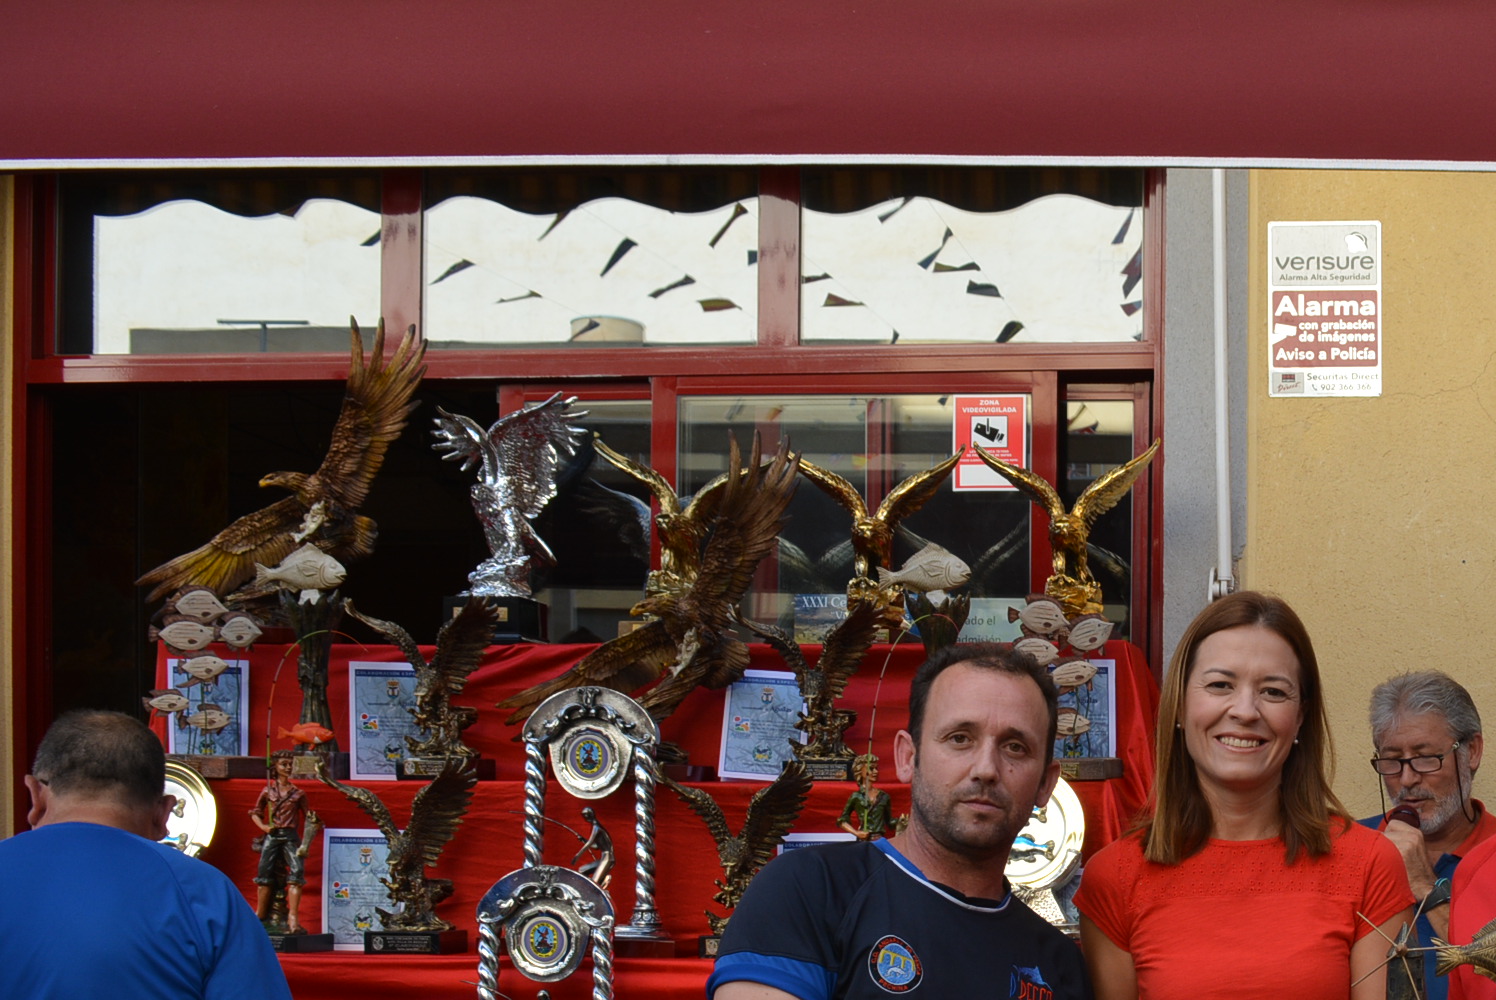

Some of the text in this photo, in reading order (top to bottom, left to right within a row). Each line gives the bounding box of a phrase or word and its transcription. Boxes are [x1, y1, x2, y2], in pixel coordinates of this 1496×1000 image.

[1275, 255, 1374, 270] verisure
[1330, 273, 1371, 283] Seguridad
[1274, 294, 1376, 316] Alarma
[1298, 320, 1375, 332] con grabación
[1298, 331, 1375, 344] de imágenes
[1276, 347, 1376, 360] Aviso a Policía
[802, 597, 827, 608] XXXI
